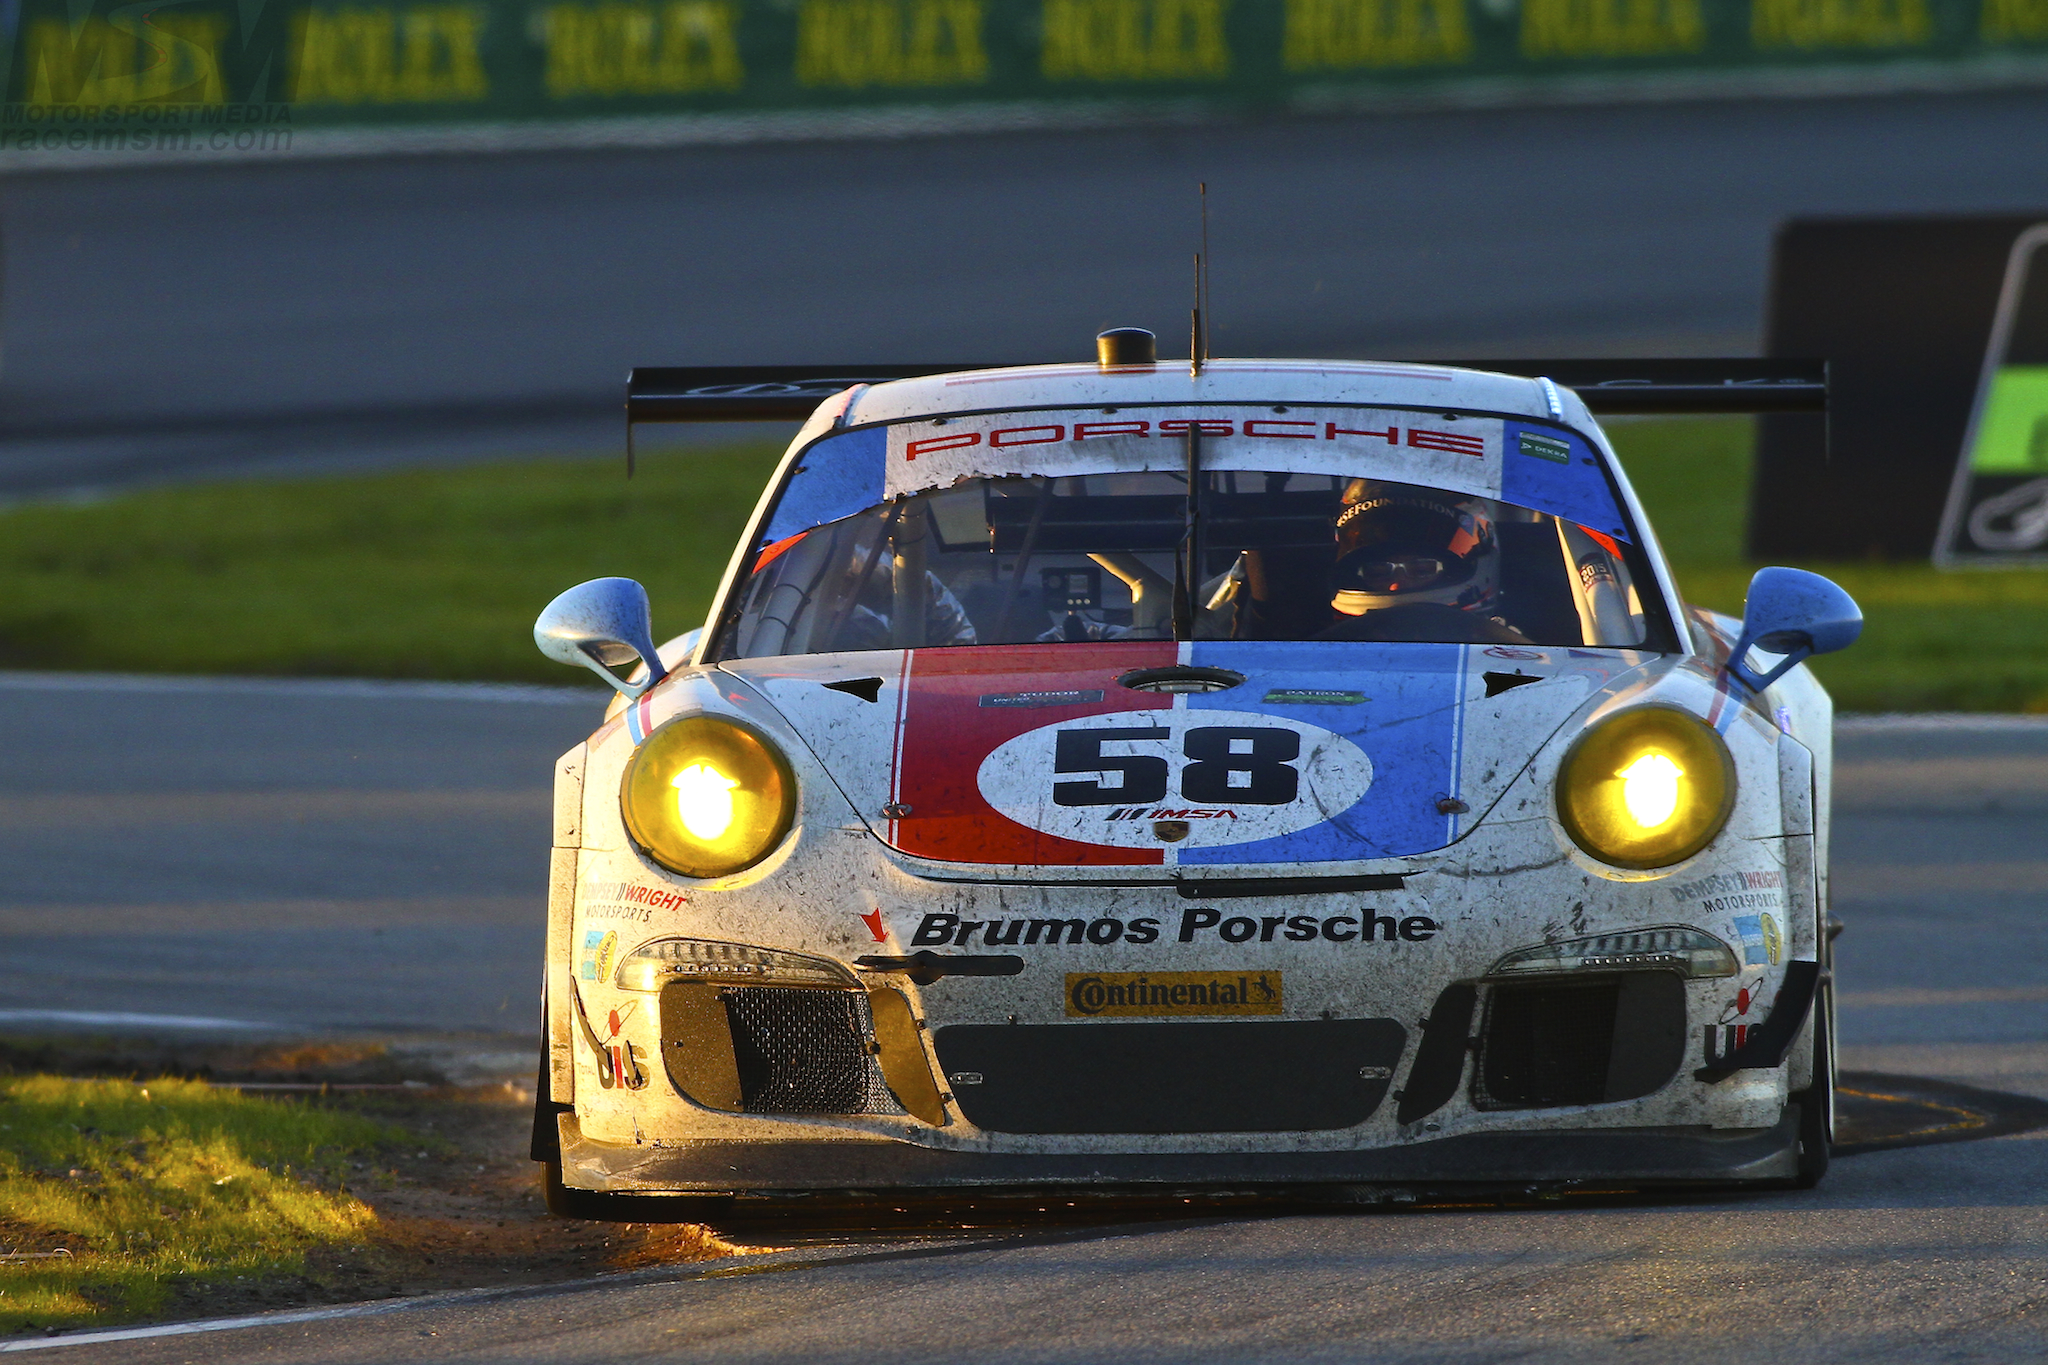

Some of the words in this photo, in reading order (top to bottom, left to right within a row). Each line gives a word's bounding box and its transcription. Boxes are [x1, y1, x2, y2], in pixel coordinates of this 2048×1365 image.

[906, 419, 1484, 462] PORSCHE
[1053, 727, 1301, 807] 58
[1147, 809, 1238, 820] IMSA
[585, 904, 653, 923] MOTORSPORTS
[1703, 893, 1780, 914] MOTORSPORTS
[911, 913, 1161, 946] Brumos
[1178, 908, 1437, 943] Porsche
[1071, 976, 1250, 1015] Continental
